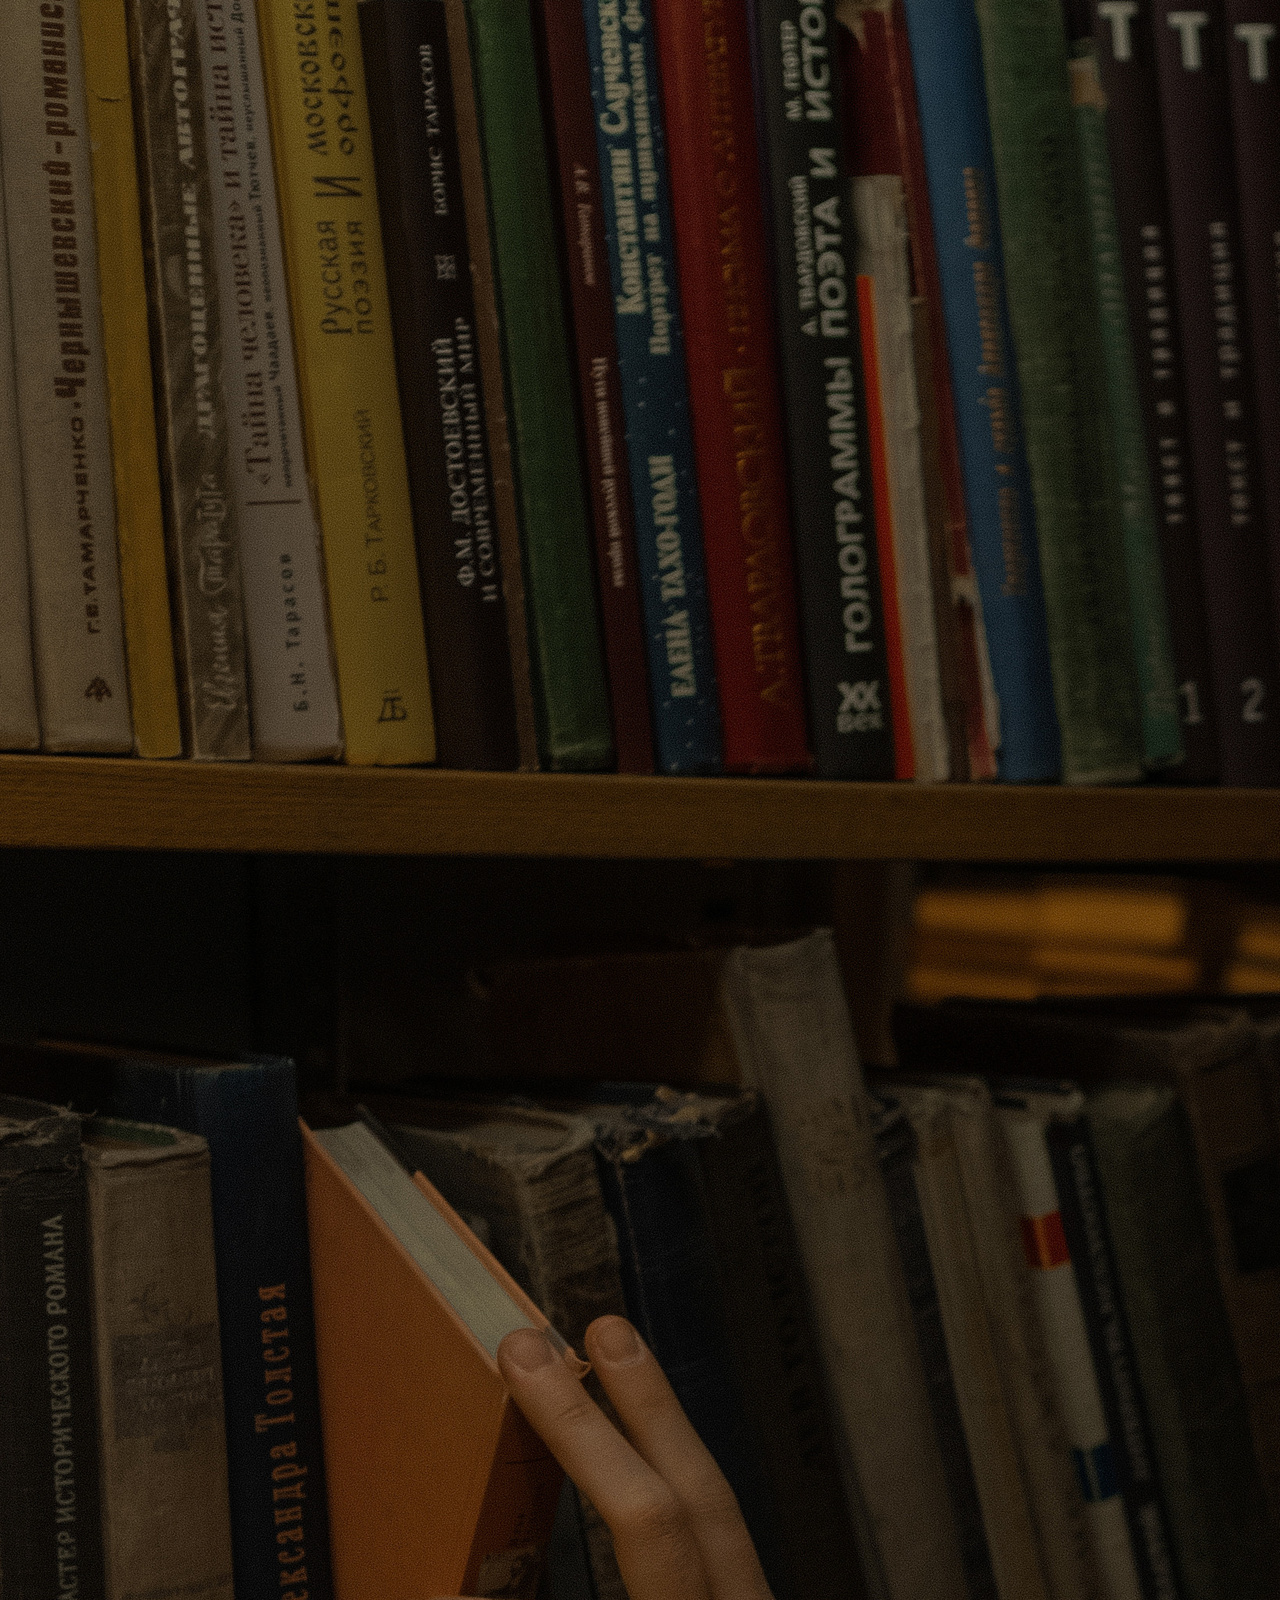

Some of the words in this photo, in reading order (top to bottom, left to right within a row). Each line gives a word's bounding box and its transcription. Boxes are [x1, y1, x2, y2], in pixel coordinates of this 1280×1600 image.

[229, 0, 247, 24] До
[780, 18, 802, 92] ГЕФТЕР
[799, 0, 835, 123] ИСТО
[208, 63, 239, 160] тайна
[419, 43, 441, 138] ТАРАСОВ
[627, 41, 660, 202] пушкинском
[784, 94, 804, 122] М.
[222, 171, 242, 188] и
[312, 175, 362, 199] И
[427, 146, 449, 216] БОРИС
[715, 169, 739, 198] О
[808, 147, 839, 179] И
[607, 147, 648, 316] Константин
[642, 212, 662, 243] на
[716, 204, 751, 334] ПИСЬМА
[787, 174, 818, 311] ТВАРДОВСКИЙ
[812, 195, 850, 340] ПОЭТА
[181, 181, 218, 439] ДРАГОЦЕННЫЕ
[226, 200, 259, 361] человека»
[316, 219, 354, 338] Русская
[645, 251, 674, 356] Портрет
[801, 315, 819, 336] А.
[454, 316, 476, 373] МИР
[241, 371, 272, 486] «Тайна
[430, 336, 469, 526] ДОСТОЕВСКИЙ
[1155, 399, 1176, 419] и
[1222, 399, 1243, 420] и
[70, 415, 101, 635] Г.Е.ТАМАРЧЕНКО
[352, 408, 384, 549] ТАРКОВСКИЙ
[457, 381, 497, 577] СОВРЕМЕННЫЙ
[822, 355, 875, 655] ГОЛОГРАММЫ
[195, 472, 231, 596] Таратута
[366, 554, 388, 576] Б.
[454, 530, 477, 588] Ф.М.
[647, 454, 687, 603] ТАХО-ГОДИ
[279, 552, 305, 651] Тарасов
[371, 584, 389, 602] Р.
[482, 583, 498, 602] И
[202, 604, 238, 711] Евгения
[660, 608, 697, 699] ЕЛЕНА
[1178, 681, 1203, 725] 1
[1239, 677, 1270, 724] 2
[40, 1213, 68, 1317] РОМАНА
[254, 1283, 296, 1434] Толстая
[44, 1324, 77, 1524] ИСТОРИЧЕСКОГО
